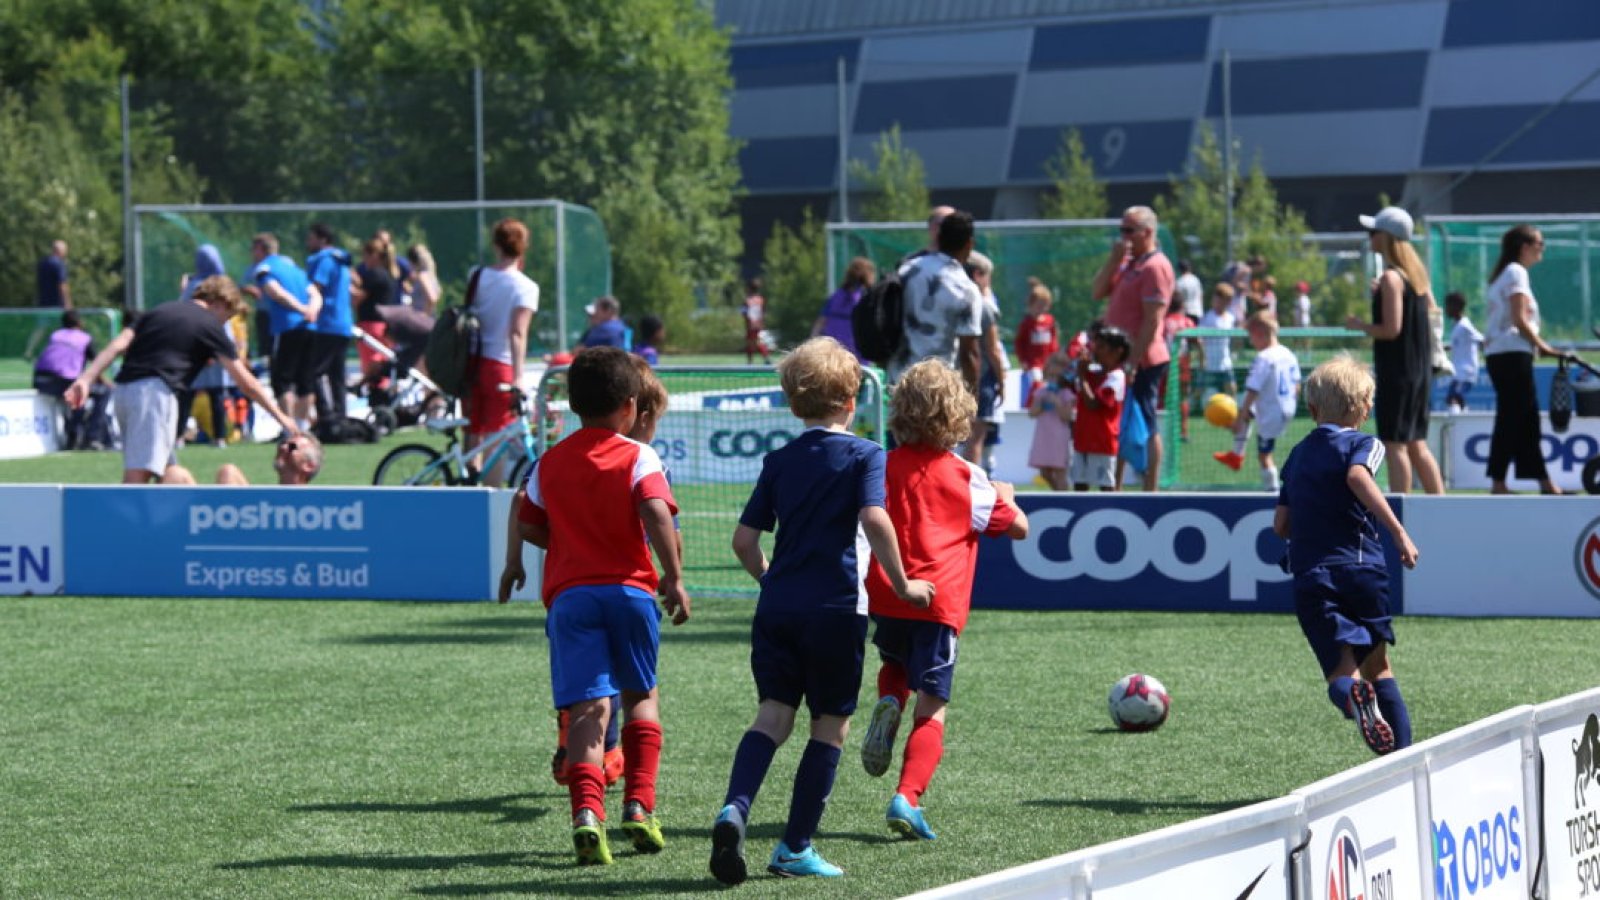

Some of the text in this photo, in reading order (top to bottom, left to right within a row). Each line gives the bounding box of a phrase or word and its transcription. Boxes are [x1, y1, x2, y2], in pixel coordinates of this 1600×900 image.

[1103, 128, 1127, 169] 9
[1464, 433, 1598, 472] cop
[189, 500, 363, 534] postnord
[1012, 508, 1286, 600] coop
[186, 562, 368, 590] Express & Bud
[1463, 805, 1521, 895] OBOS
[1578, 854, 1600, 898] SPO
